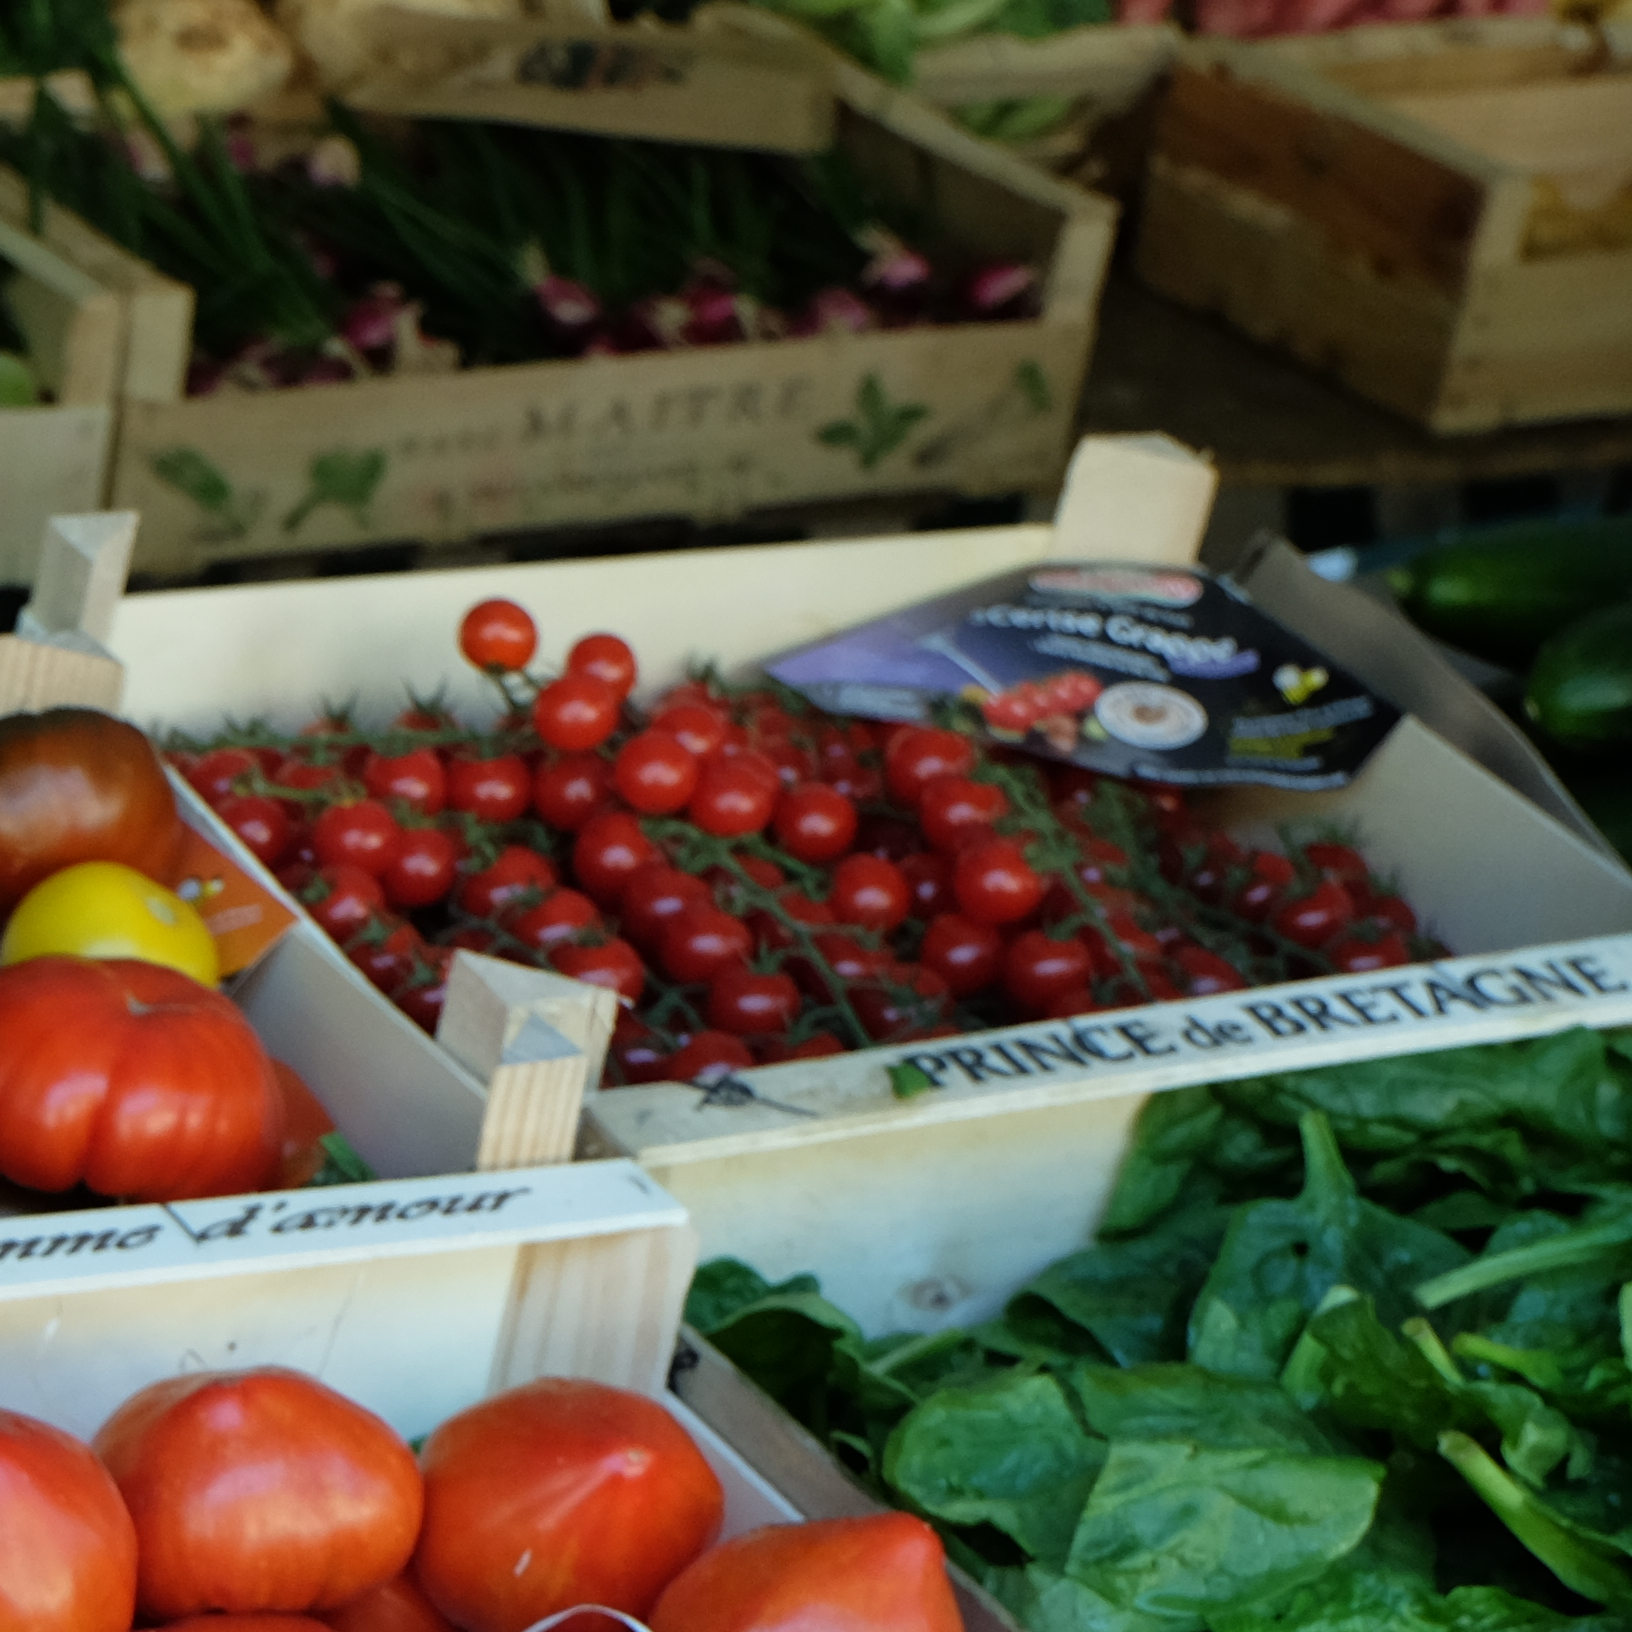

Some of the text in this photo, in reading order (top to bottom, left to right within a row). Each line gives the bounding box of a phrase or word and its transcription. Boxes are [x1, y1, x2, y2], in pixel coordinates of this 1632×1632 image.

[905, 953, 1630, 1088] PRINCE de BRETAGNE
[195, 1186, 532, 1243] d'amour
